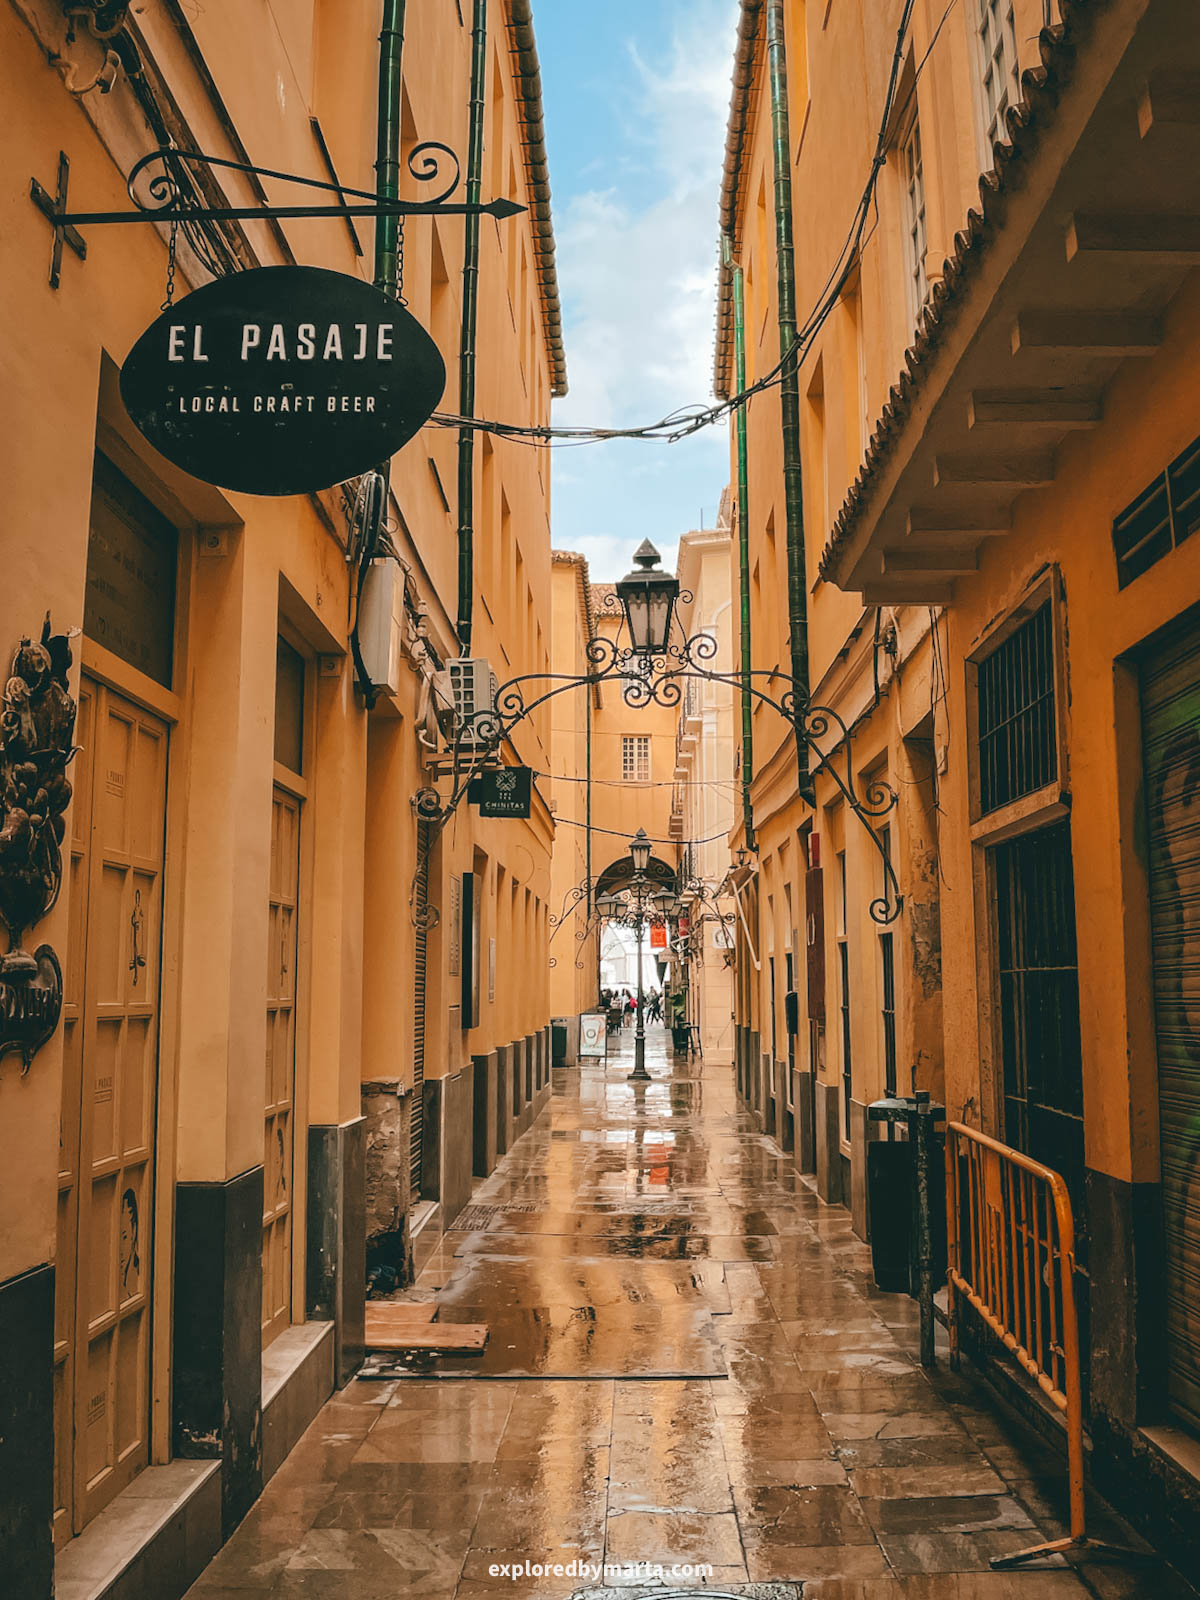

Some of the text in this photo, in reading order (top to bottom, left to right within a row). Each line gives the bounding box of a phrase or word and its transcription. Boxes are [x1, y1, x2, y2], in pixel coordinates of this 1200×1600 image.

[168, 323, 394, 362] EL PASAJE
[180, 396, 376, 413] LOCAL CRAFT BEER
[485, 801, 525, 809] CHINITAS
